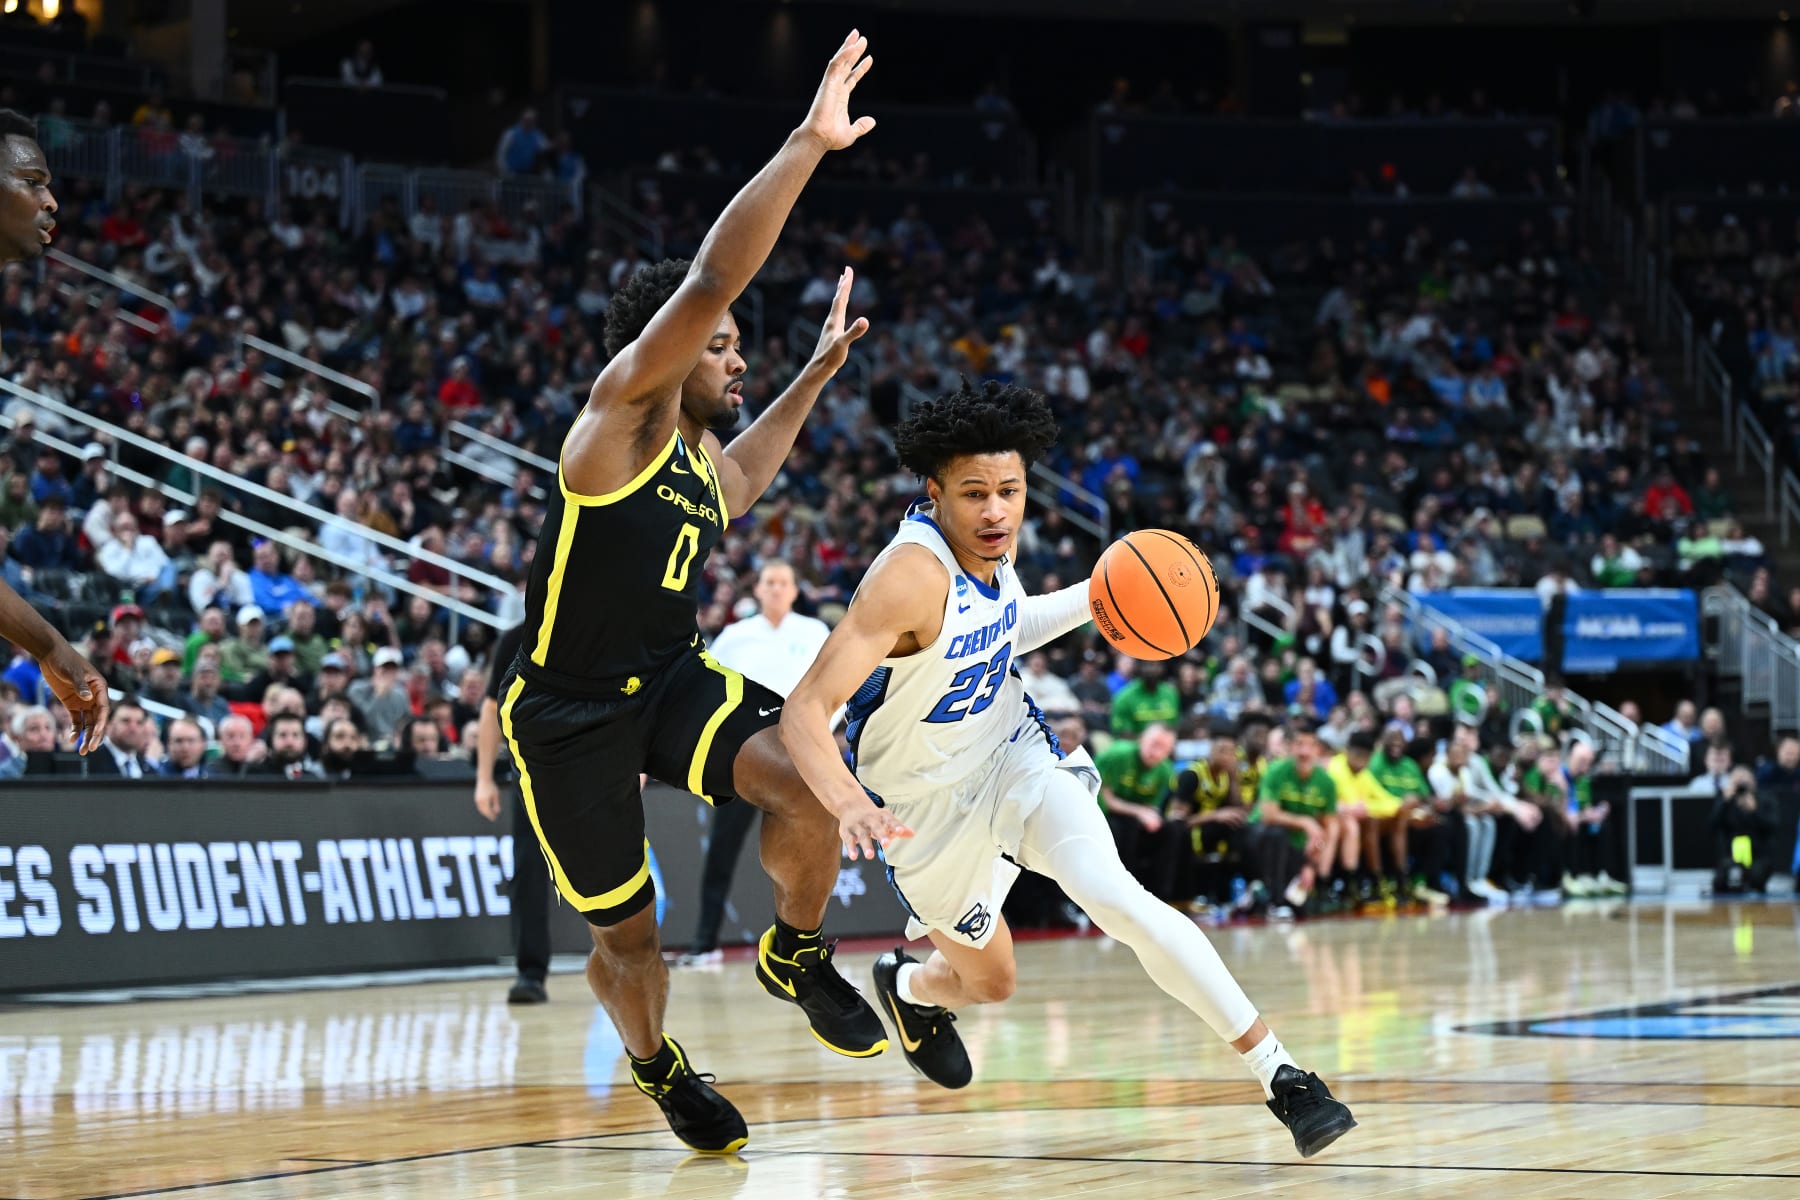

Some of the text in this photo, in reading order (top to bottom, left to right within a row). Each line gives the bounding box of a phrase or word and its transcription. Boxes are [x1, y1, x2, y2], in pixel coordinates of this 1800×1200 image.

[286, 165, 338, 199] 104
[661, 522, 700, 592] 0
[920, 641, 1012, 723] 23
